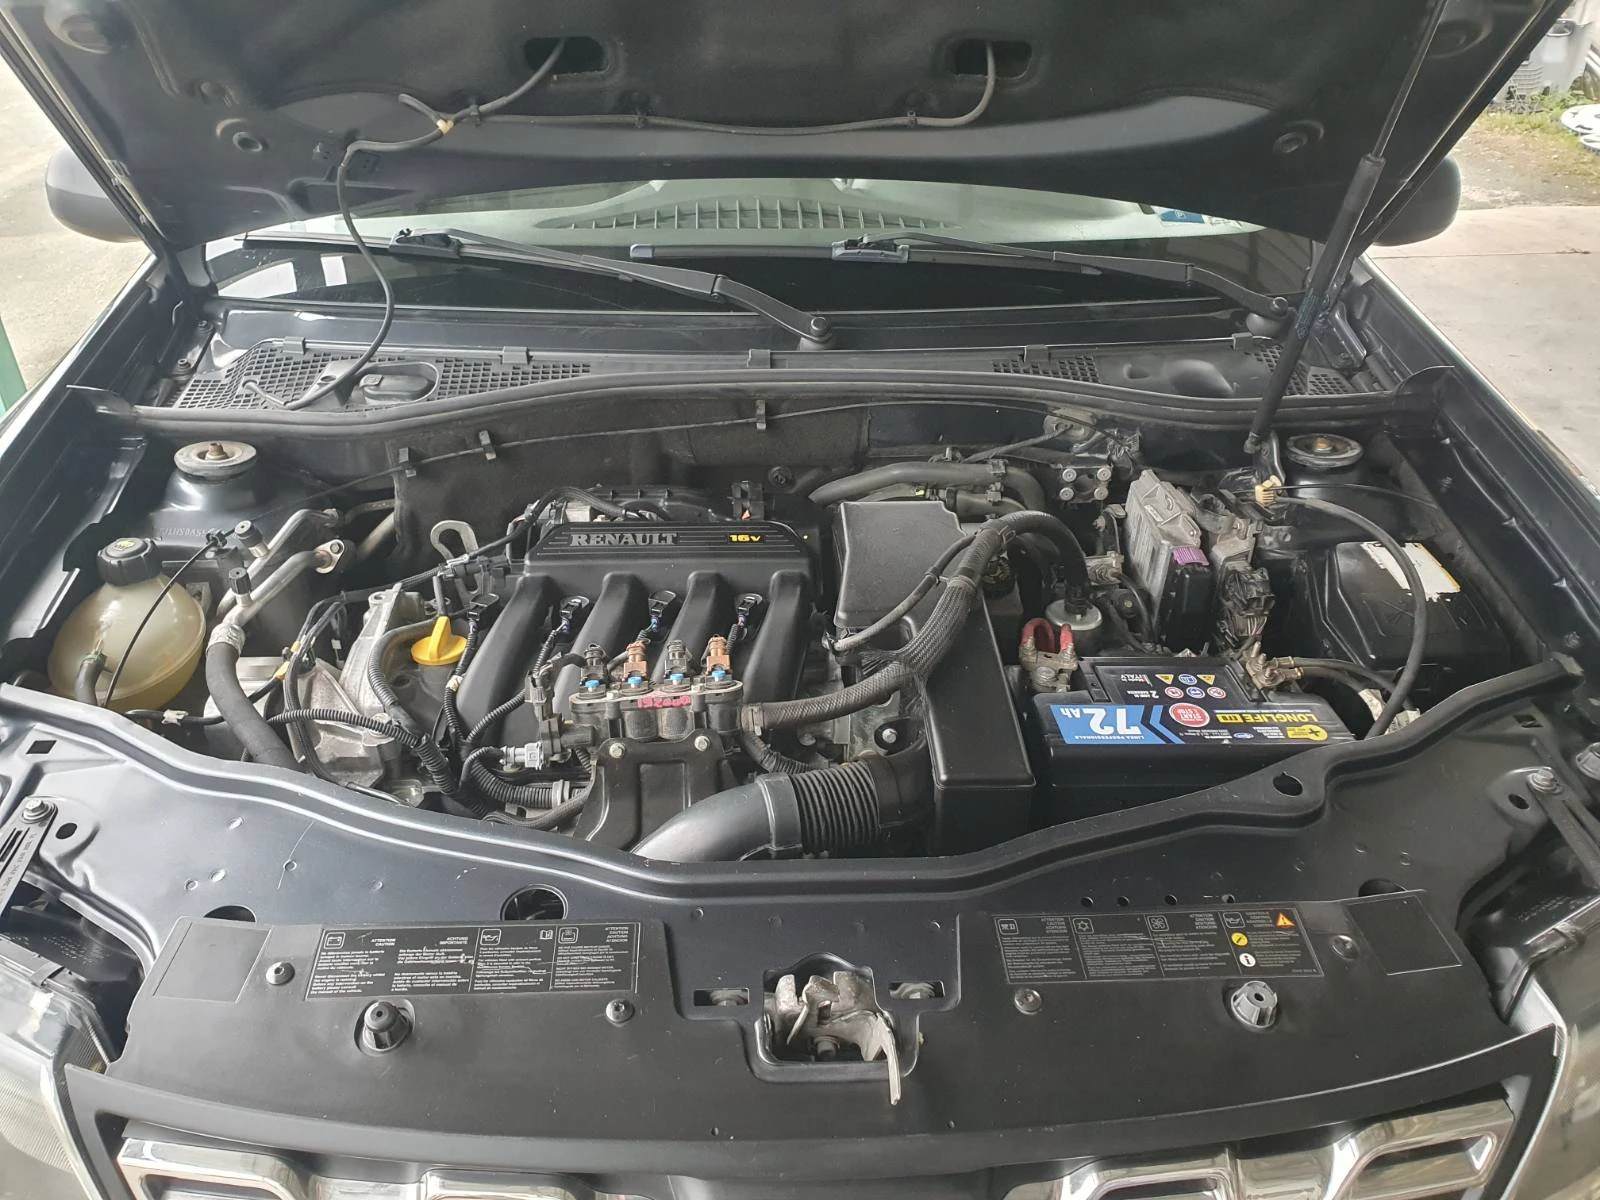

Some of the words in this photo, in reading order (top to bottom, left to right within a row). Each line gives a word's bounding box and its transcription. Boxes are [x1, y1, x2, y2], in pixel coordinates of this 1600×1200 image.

[570, 532, 677, 547] RENAULT
[728, 534, 761, 542] 16v
[1059, 707, 1081, 719] Ah
[1242, 713, 1318, 723] LONGLIFE
[1082, 708, 1142, 735] 72
